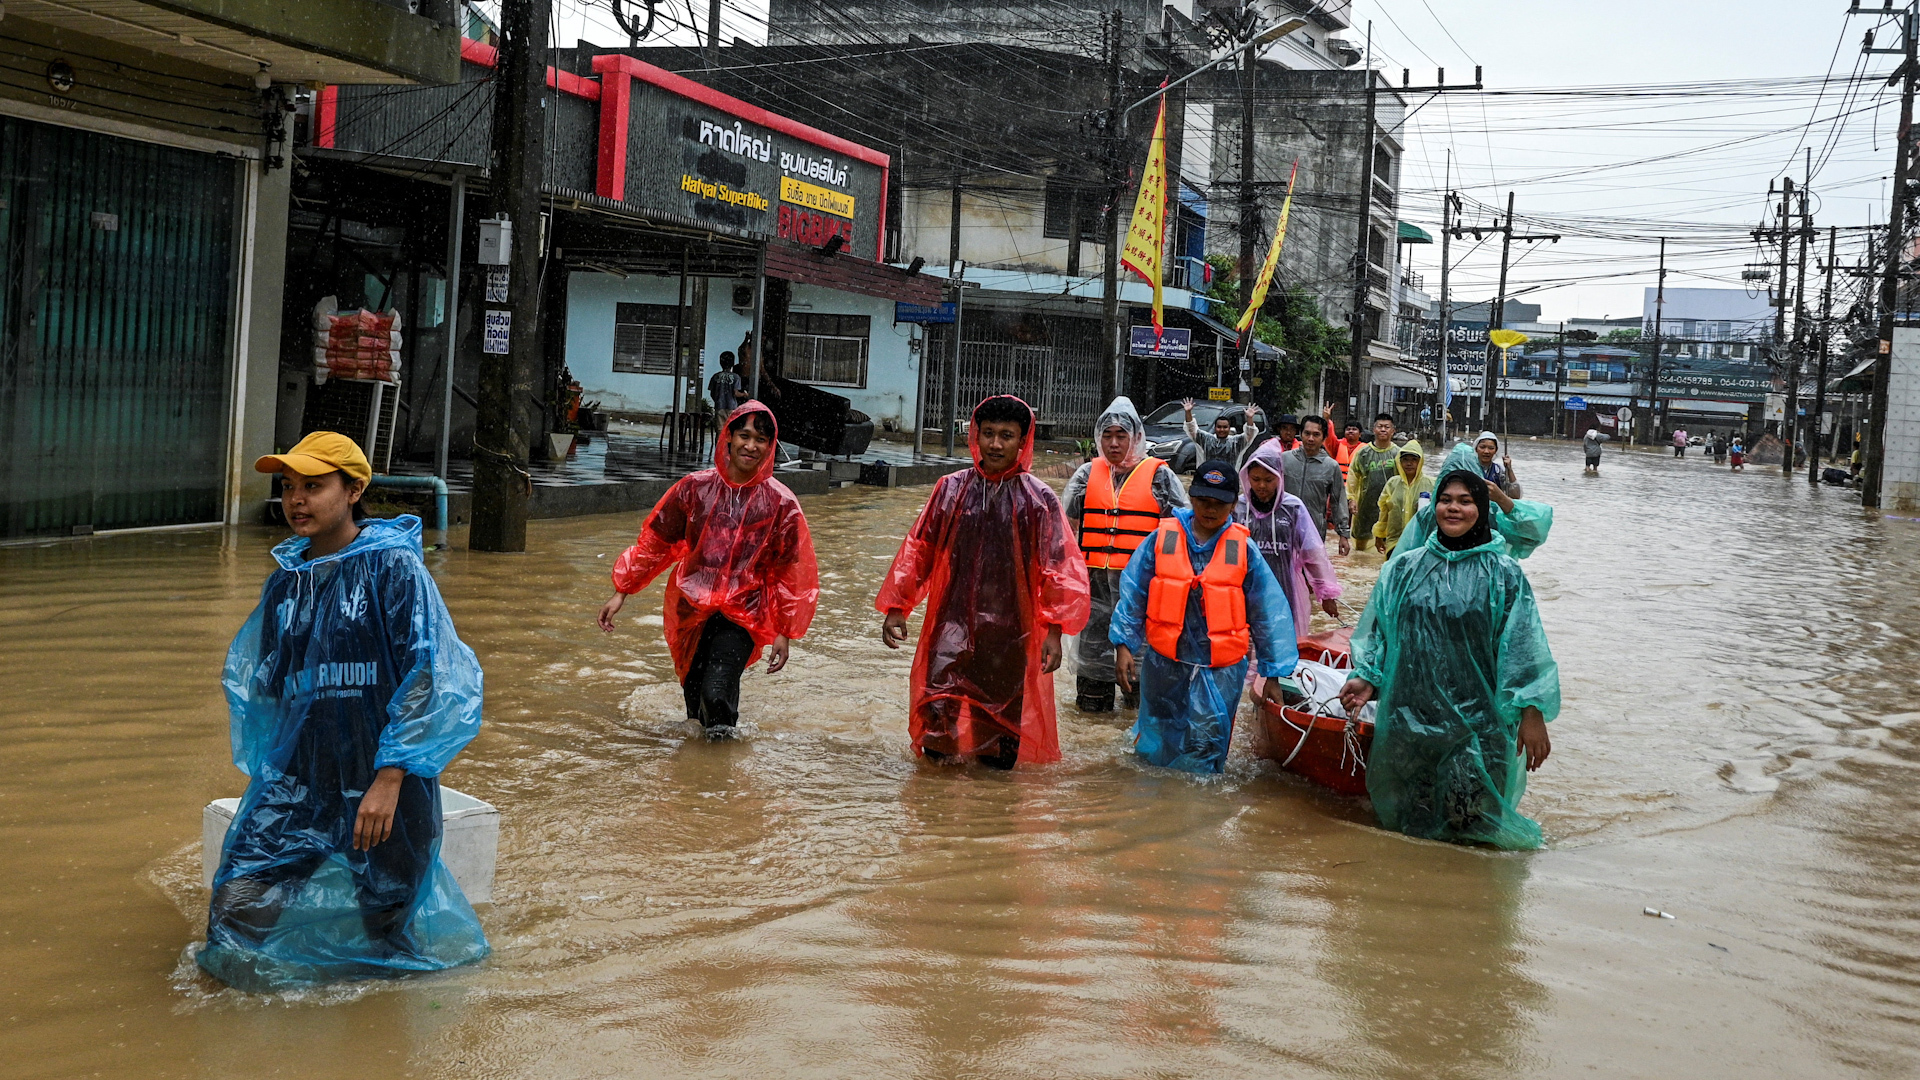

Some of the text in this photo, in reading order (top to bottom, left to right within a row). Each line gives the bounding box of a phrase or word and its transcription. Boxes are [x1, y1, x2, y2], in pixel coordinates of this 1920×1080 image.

[49, 95, 77, 109] 165/2
[699, 120, 849, 188] หาดใหญ่ ซุปเปอร์ไบค์
[681, 174, 769, 211] Hatyai SuperBike
[786, 182, 804, 202] รับซื้อ
[806, 192, 817, 206] ขาย
[777, 205, 853, 253] BIGBIKE
